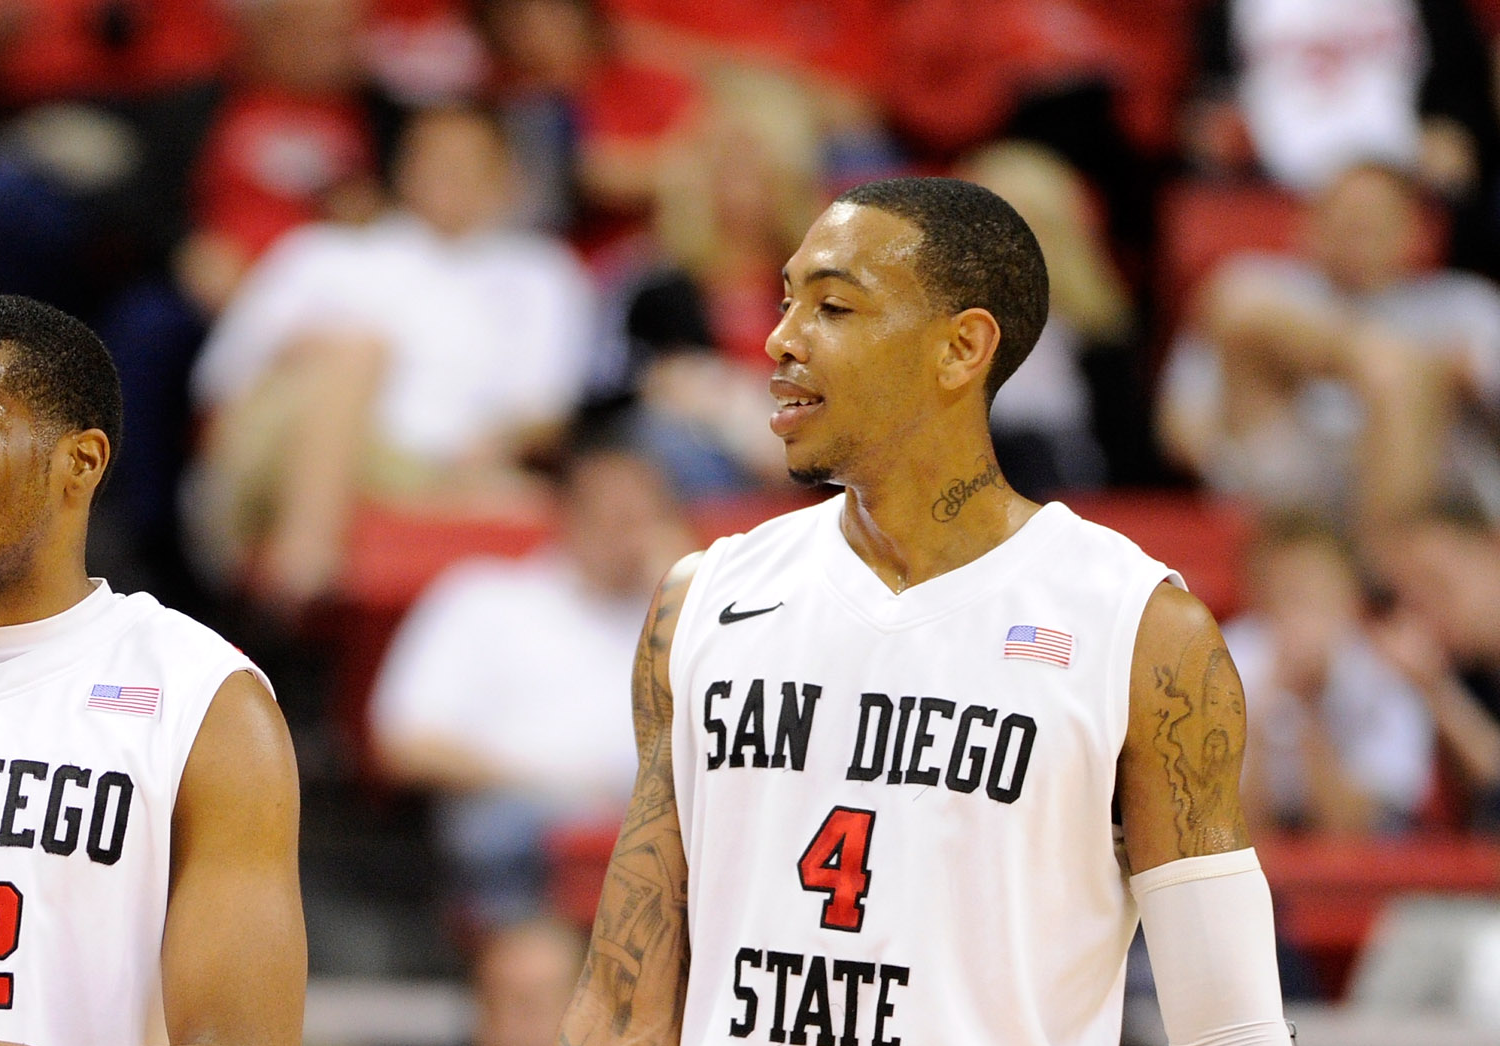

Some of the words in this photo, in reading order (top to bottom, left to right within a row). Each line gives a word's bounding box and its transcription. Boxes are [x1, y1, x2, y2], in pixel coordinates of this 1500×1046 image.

[702, 680, 823, 772] SAN
[845, 692, 1038, 805] DIEGO
[796, 805, 877, 934] 4
